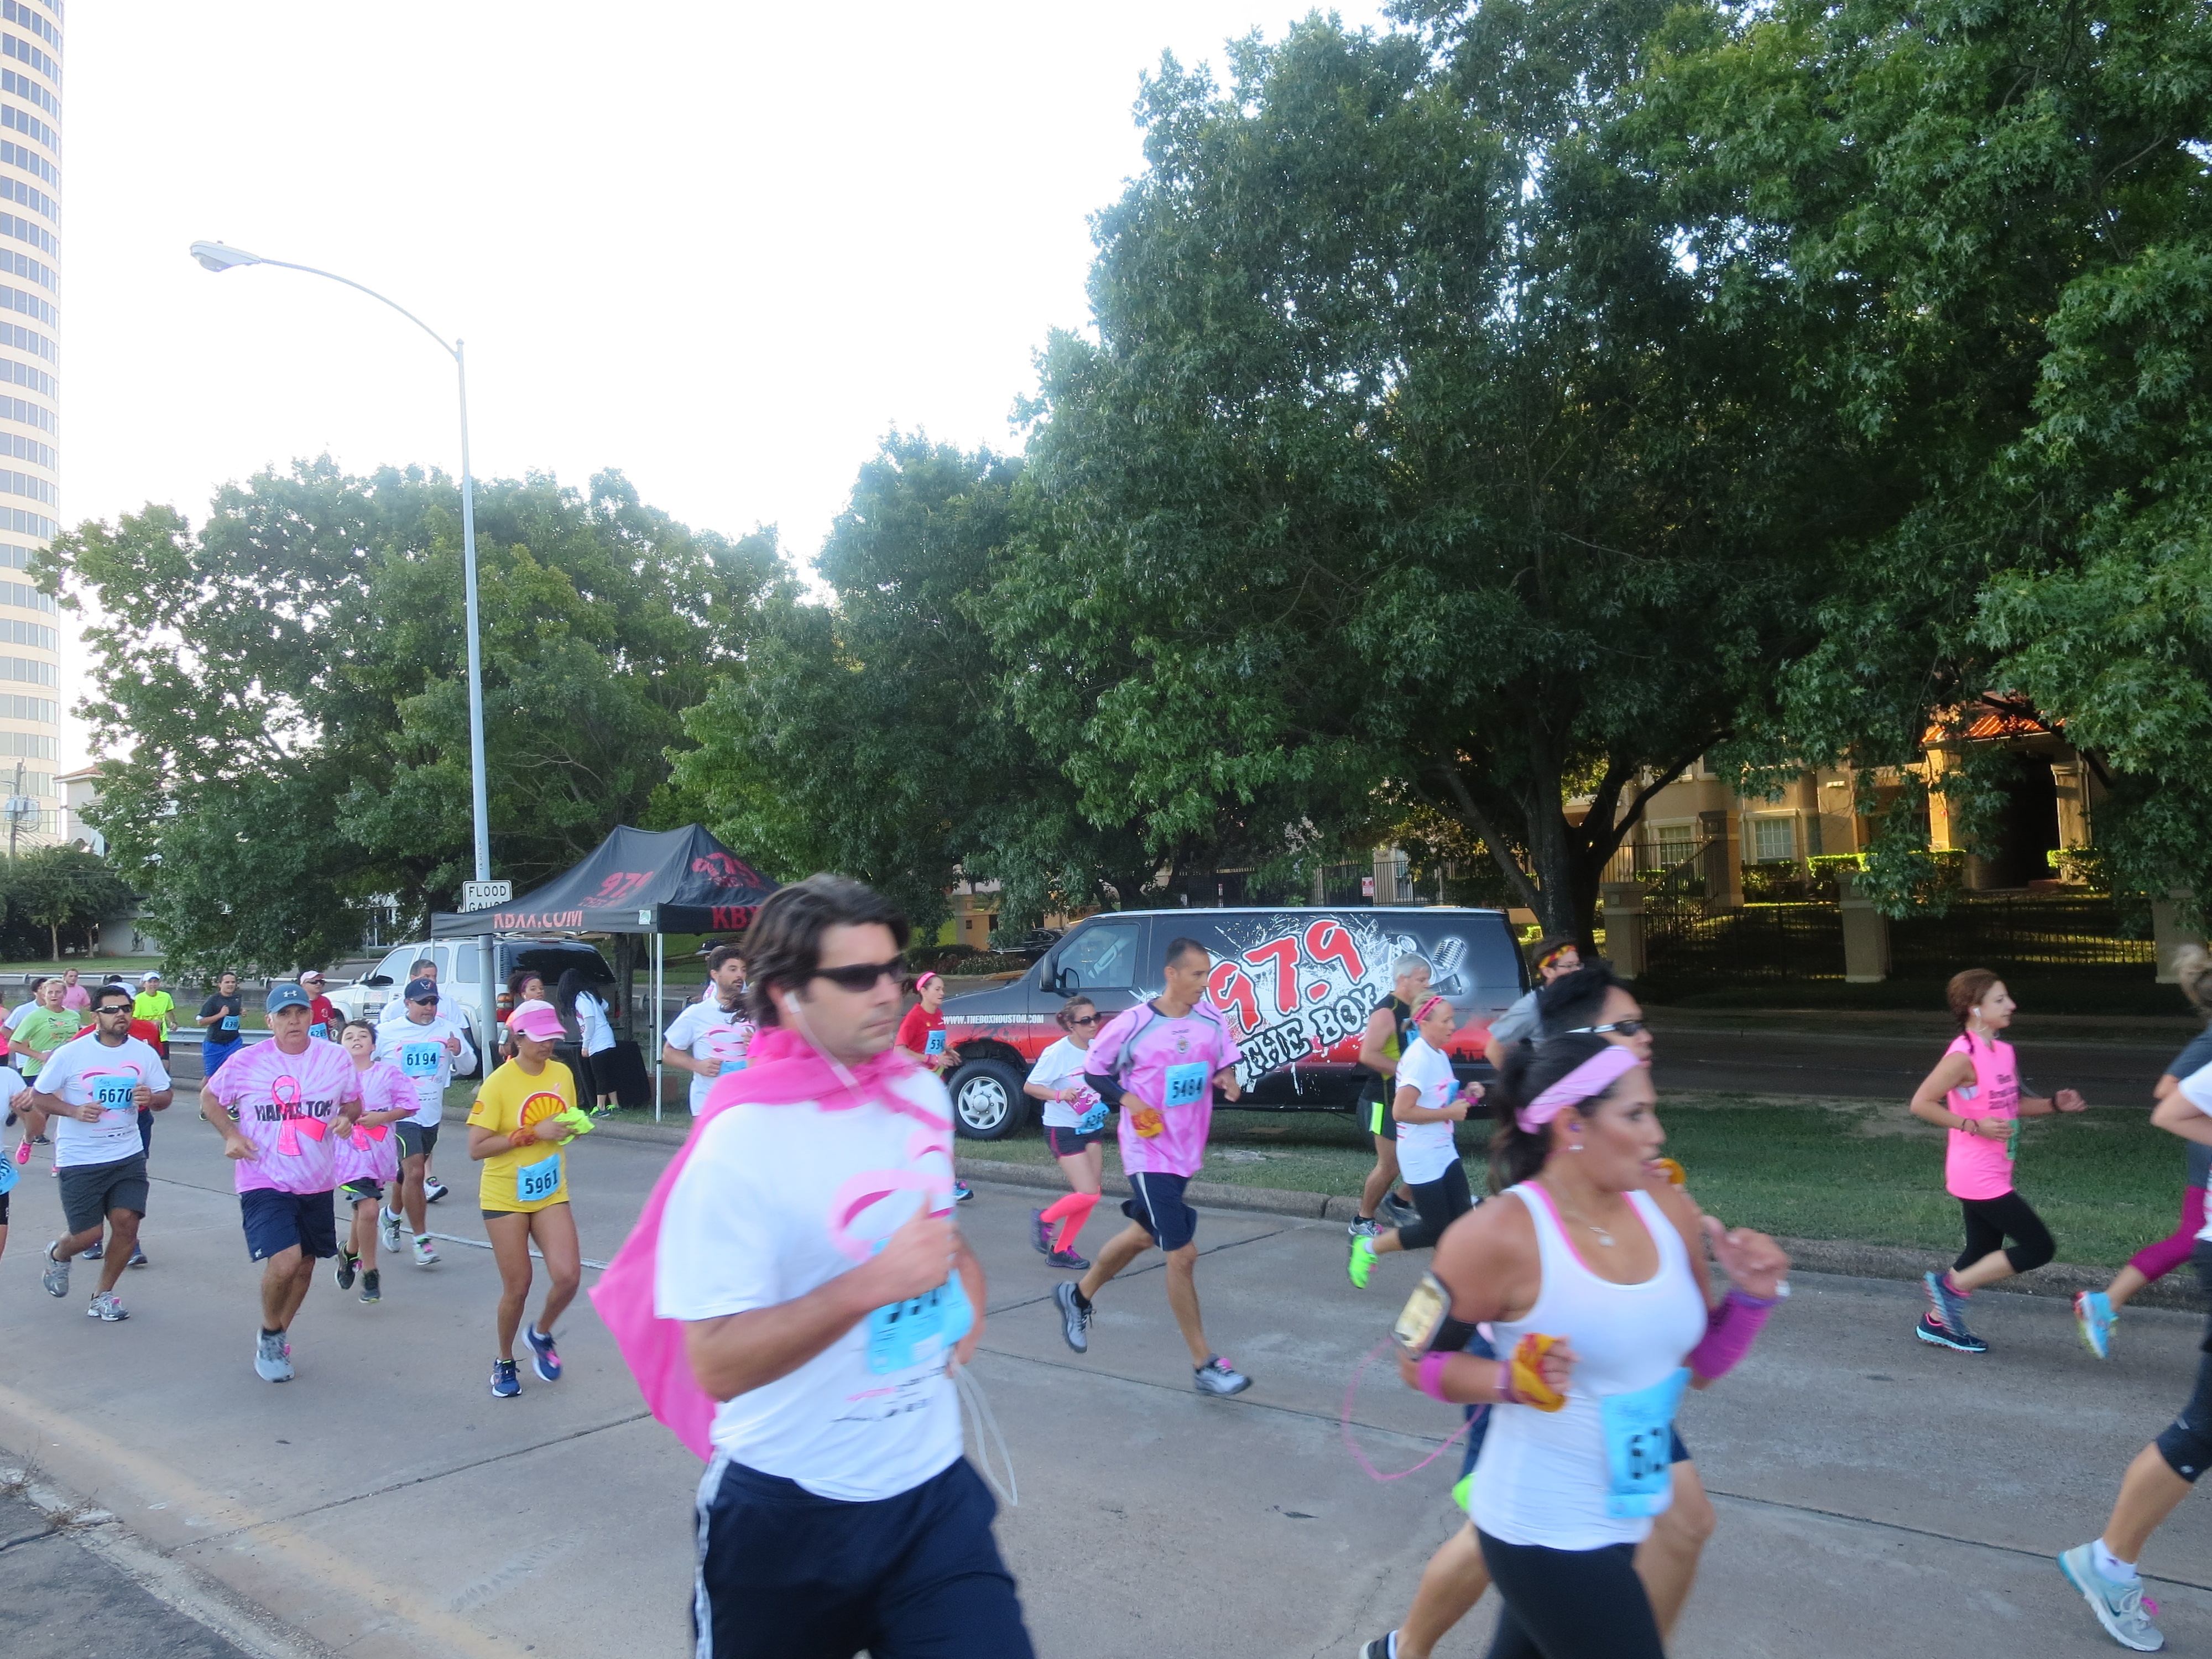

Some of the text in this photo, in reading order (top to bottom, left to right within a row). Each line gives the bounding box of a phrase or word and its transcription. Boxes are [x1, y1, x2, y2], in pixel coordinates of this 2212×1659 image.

[468, 885, 507, 897] FLOOD
[1206, 918, 1367, 1035] 97.9
[943, 1014, 1044, 1025] WWW.THEBOXHOUSTON.COM
[1238, 983, 1377, 1078] THE BOX
[406, 1052, 437, 1066] 6194
[99, 1088, 133, 1103] 6670
[524, 1168, 558, 1194] 5961
